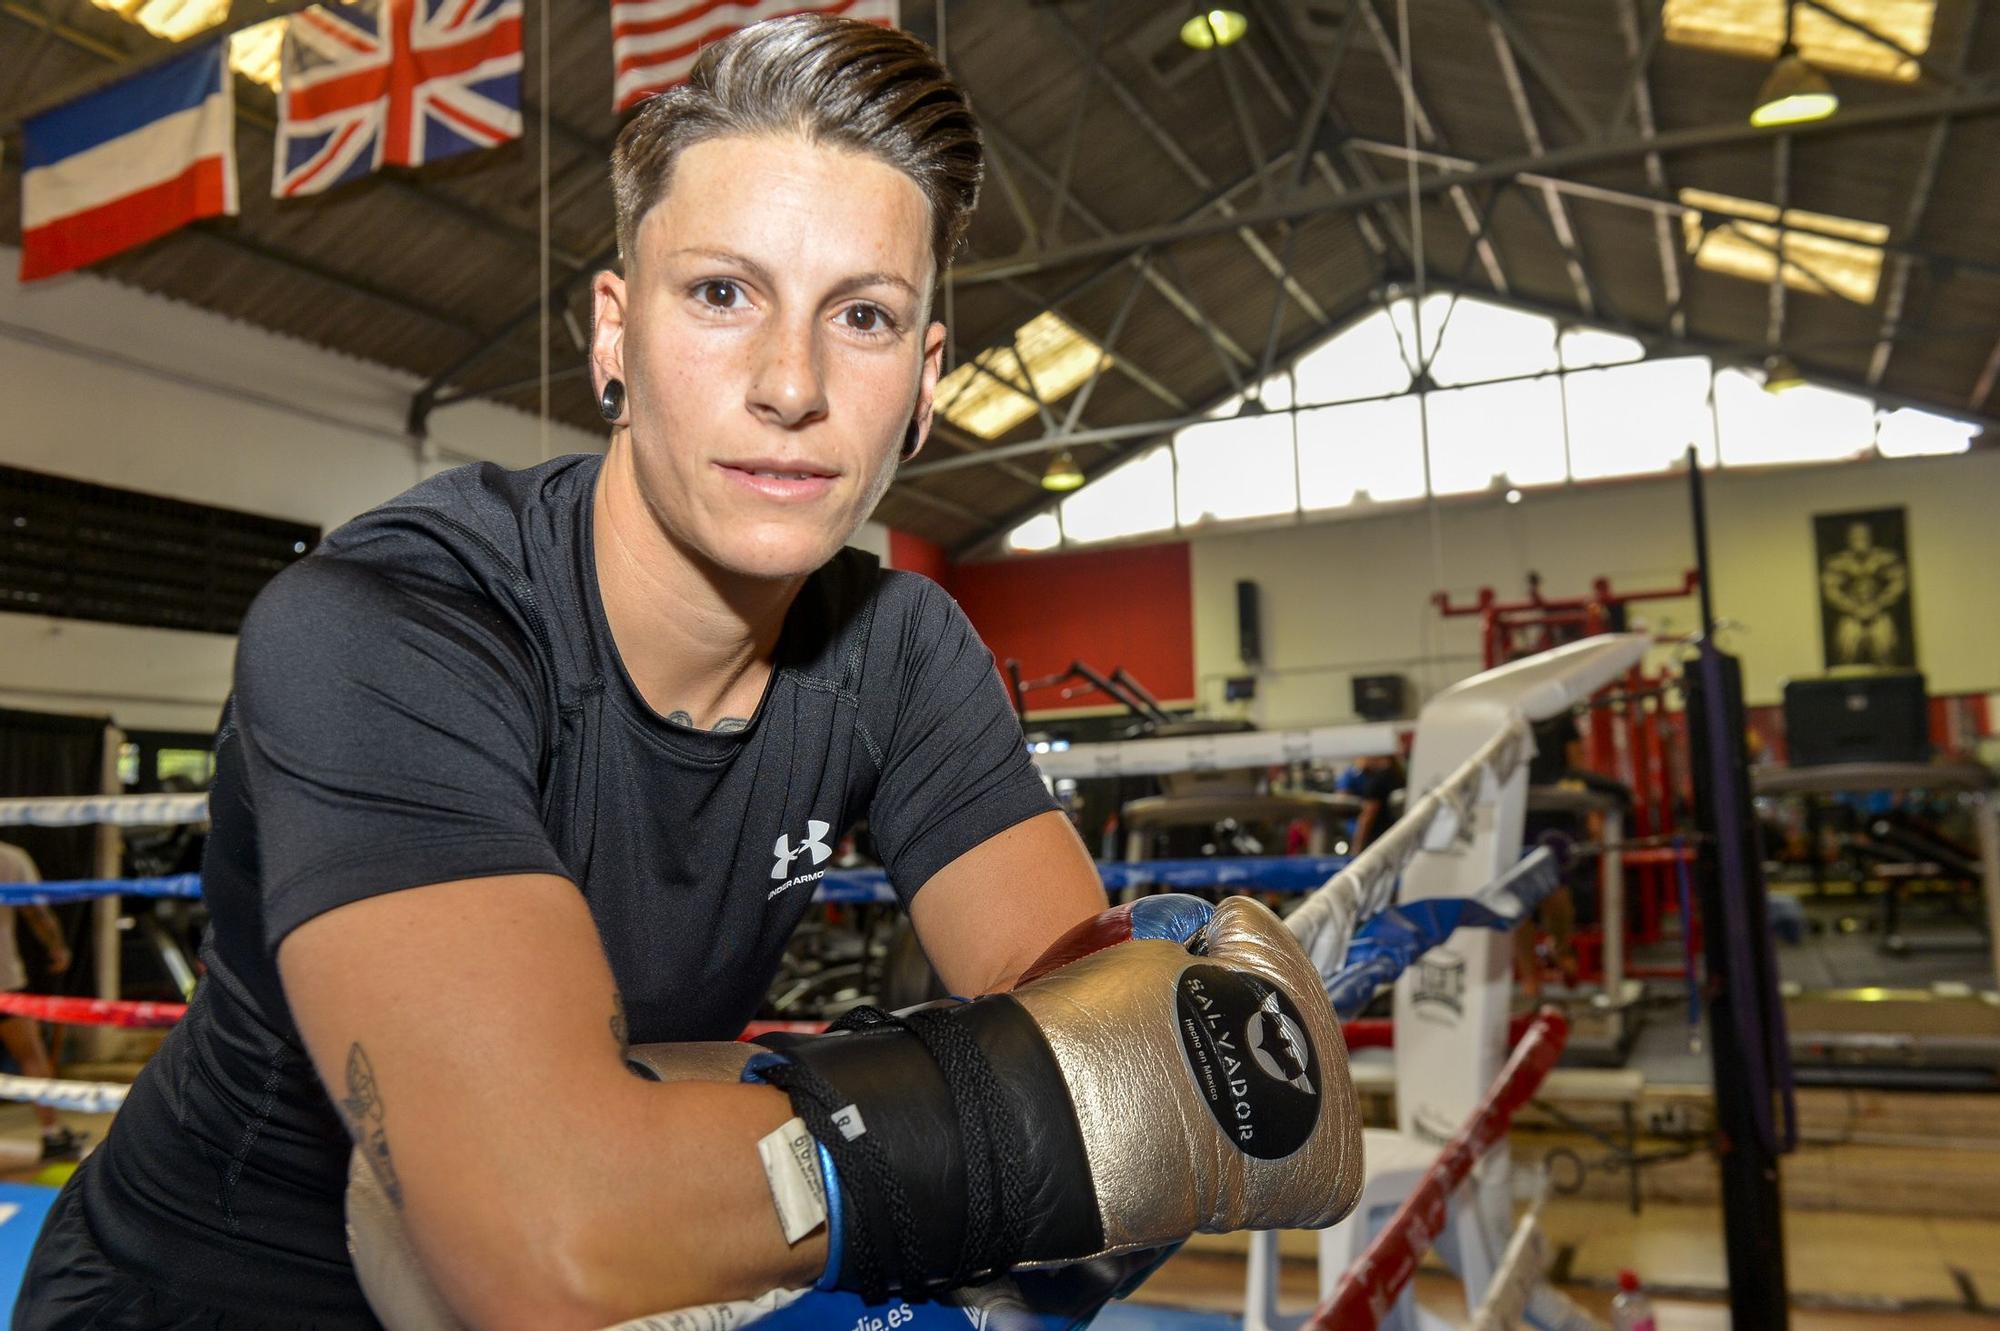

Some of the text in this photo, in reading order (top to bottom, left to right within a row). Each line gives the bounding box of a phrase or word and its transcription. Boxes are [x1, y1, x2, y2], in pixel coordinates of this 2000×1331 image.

[793, 870, 825, 886] ARMO
[1184, 1018, 1218, 1101] Hecho en Mexico
[1187, 978, 1253, 1141] SALVADOR
